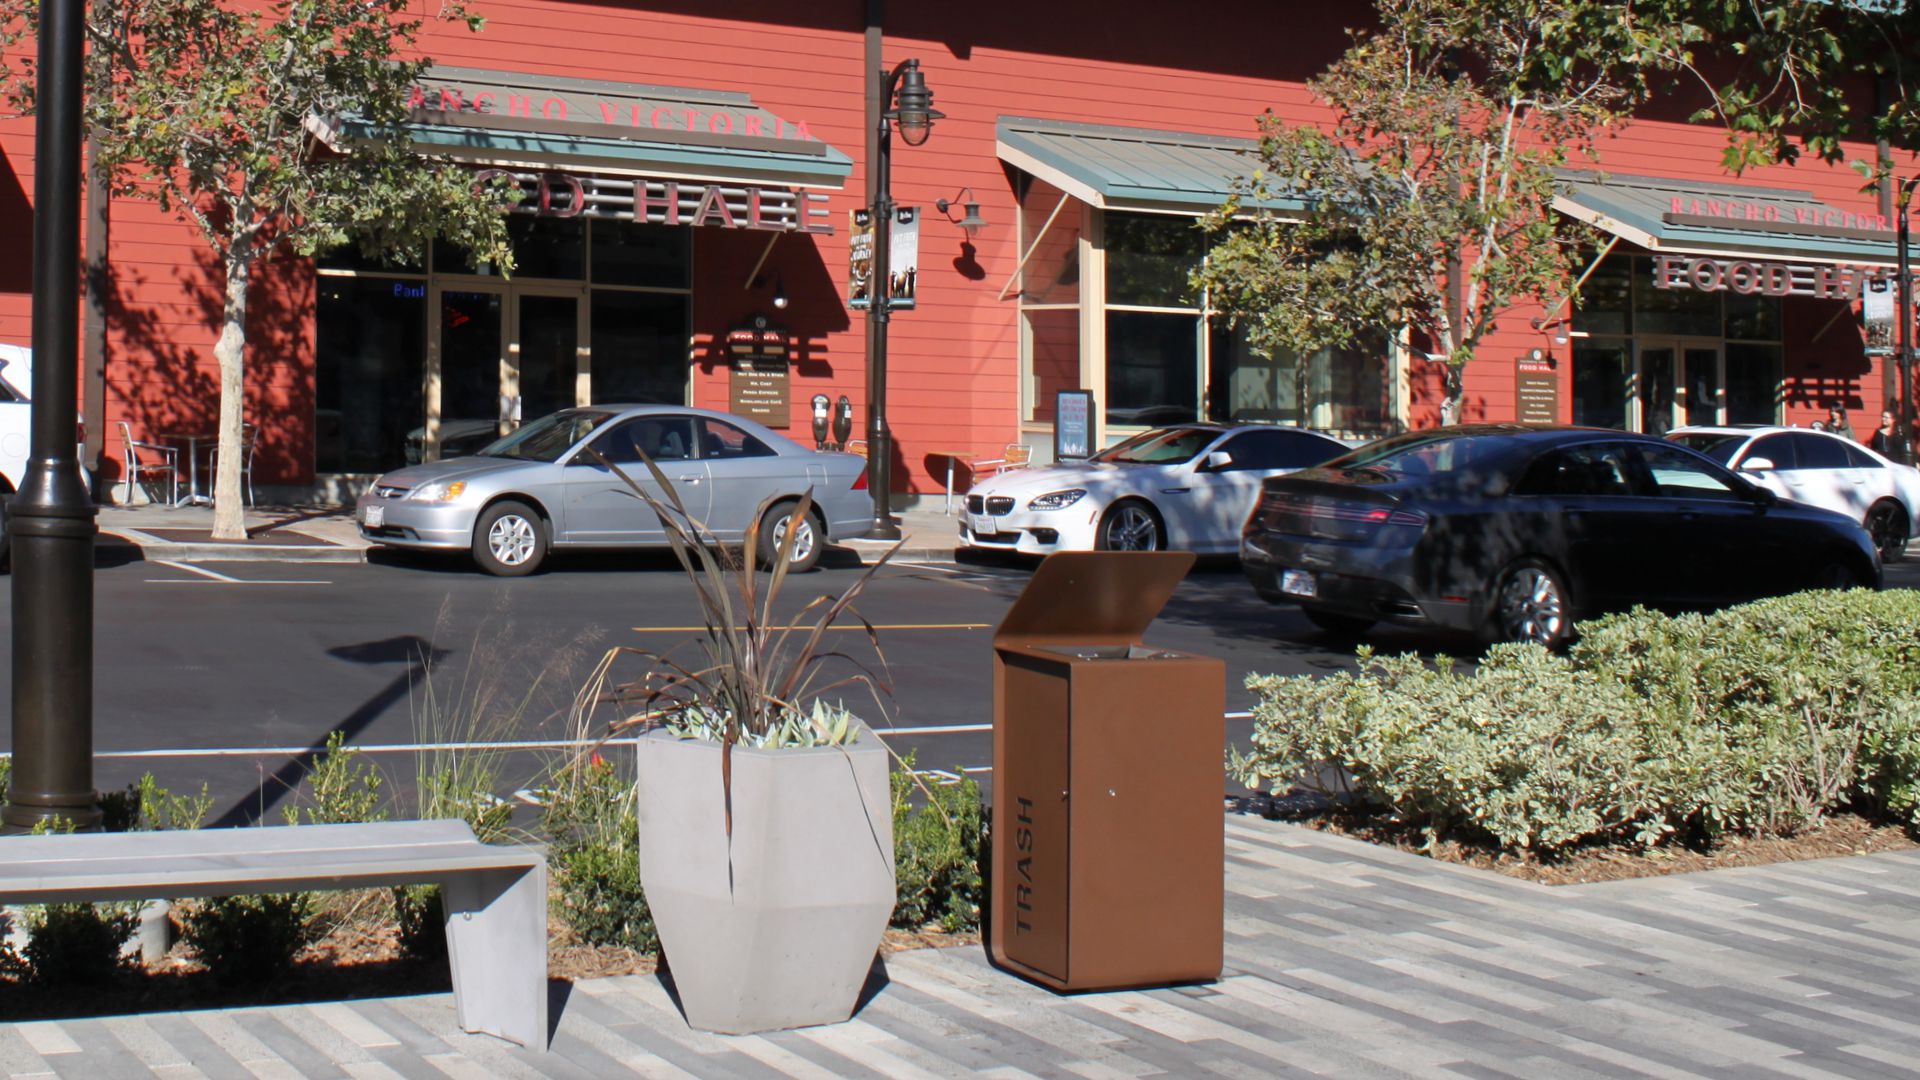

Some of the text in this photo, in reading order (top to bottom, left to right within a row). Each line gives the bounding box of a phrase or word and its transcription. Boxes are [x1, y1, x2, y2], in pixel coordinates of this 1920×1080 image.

[405, 85, 813, 141] ANCHO VICTORIA
[632, 180, 835, 236] HALL
[1670, 196, 1779, 223] RANCHO
[1656, 255, 1793, 297] FOOD
[1016, 796, 1033, 936] TRASH
